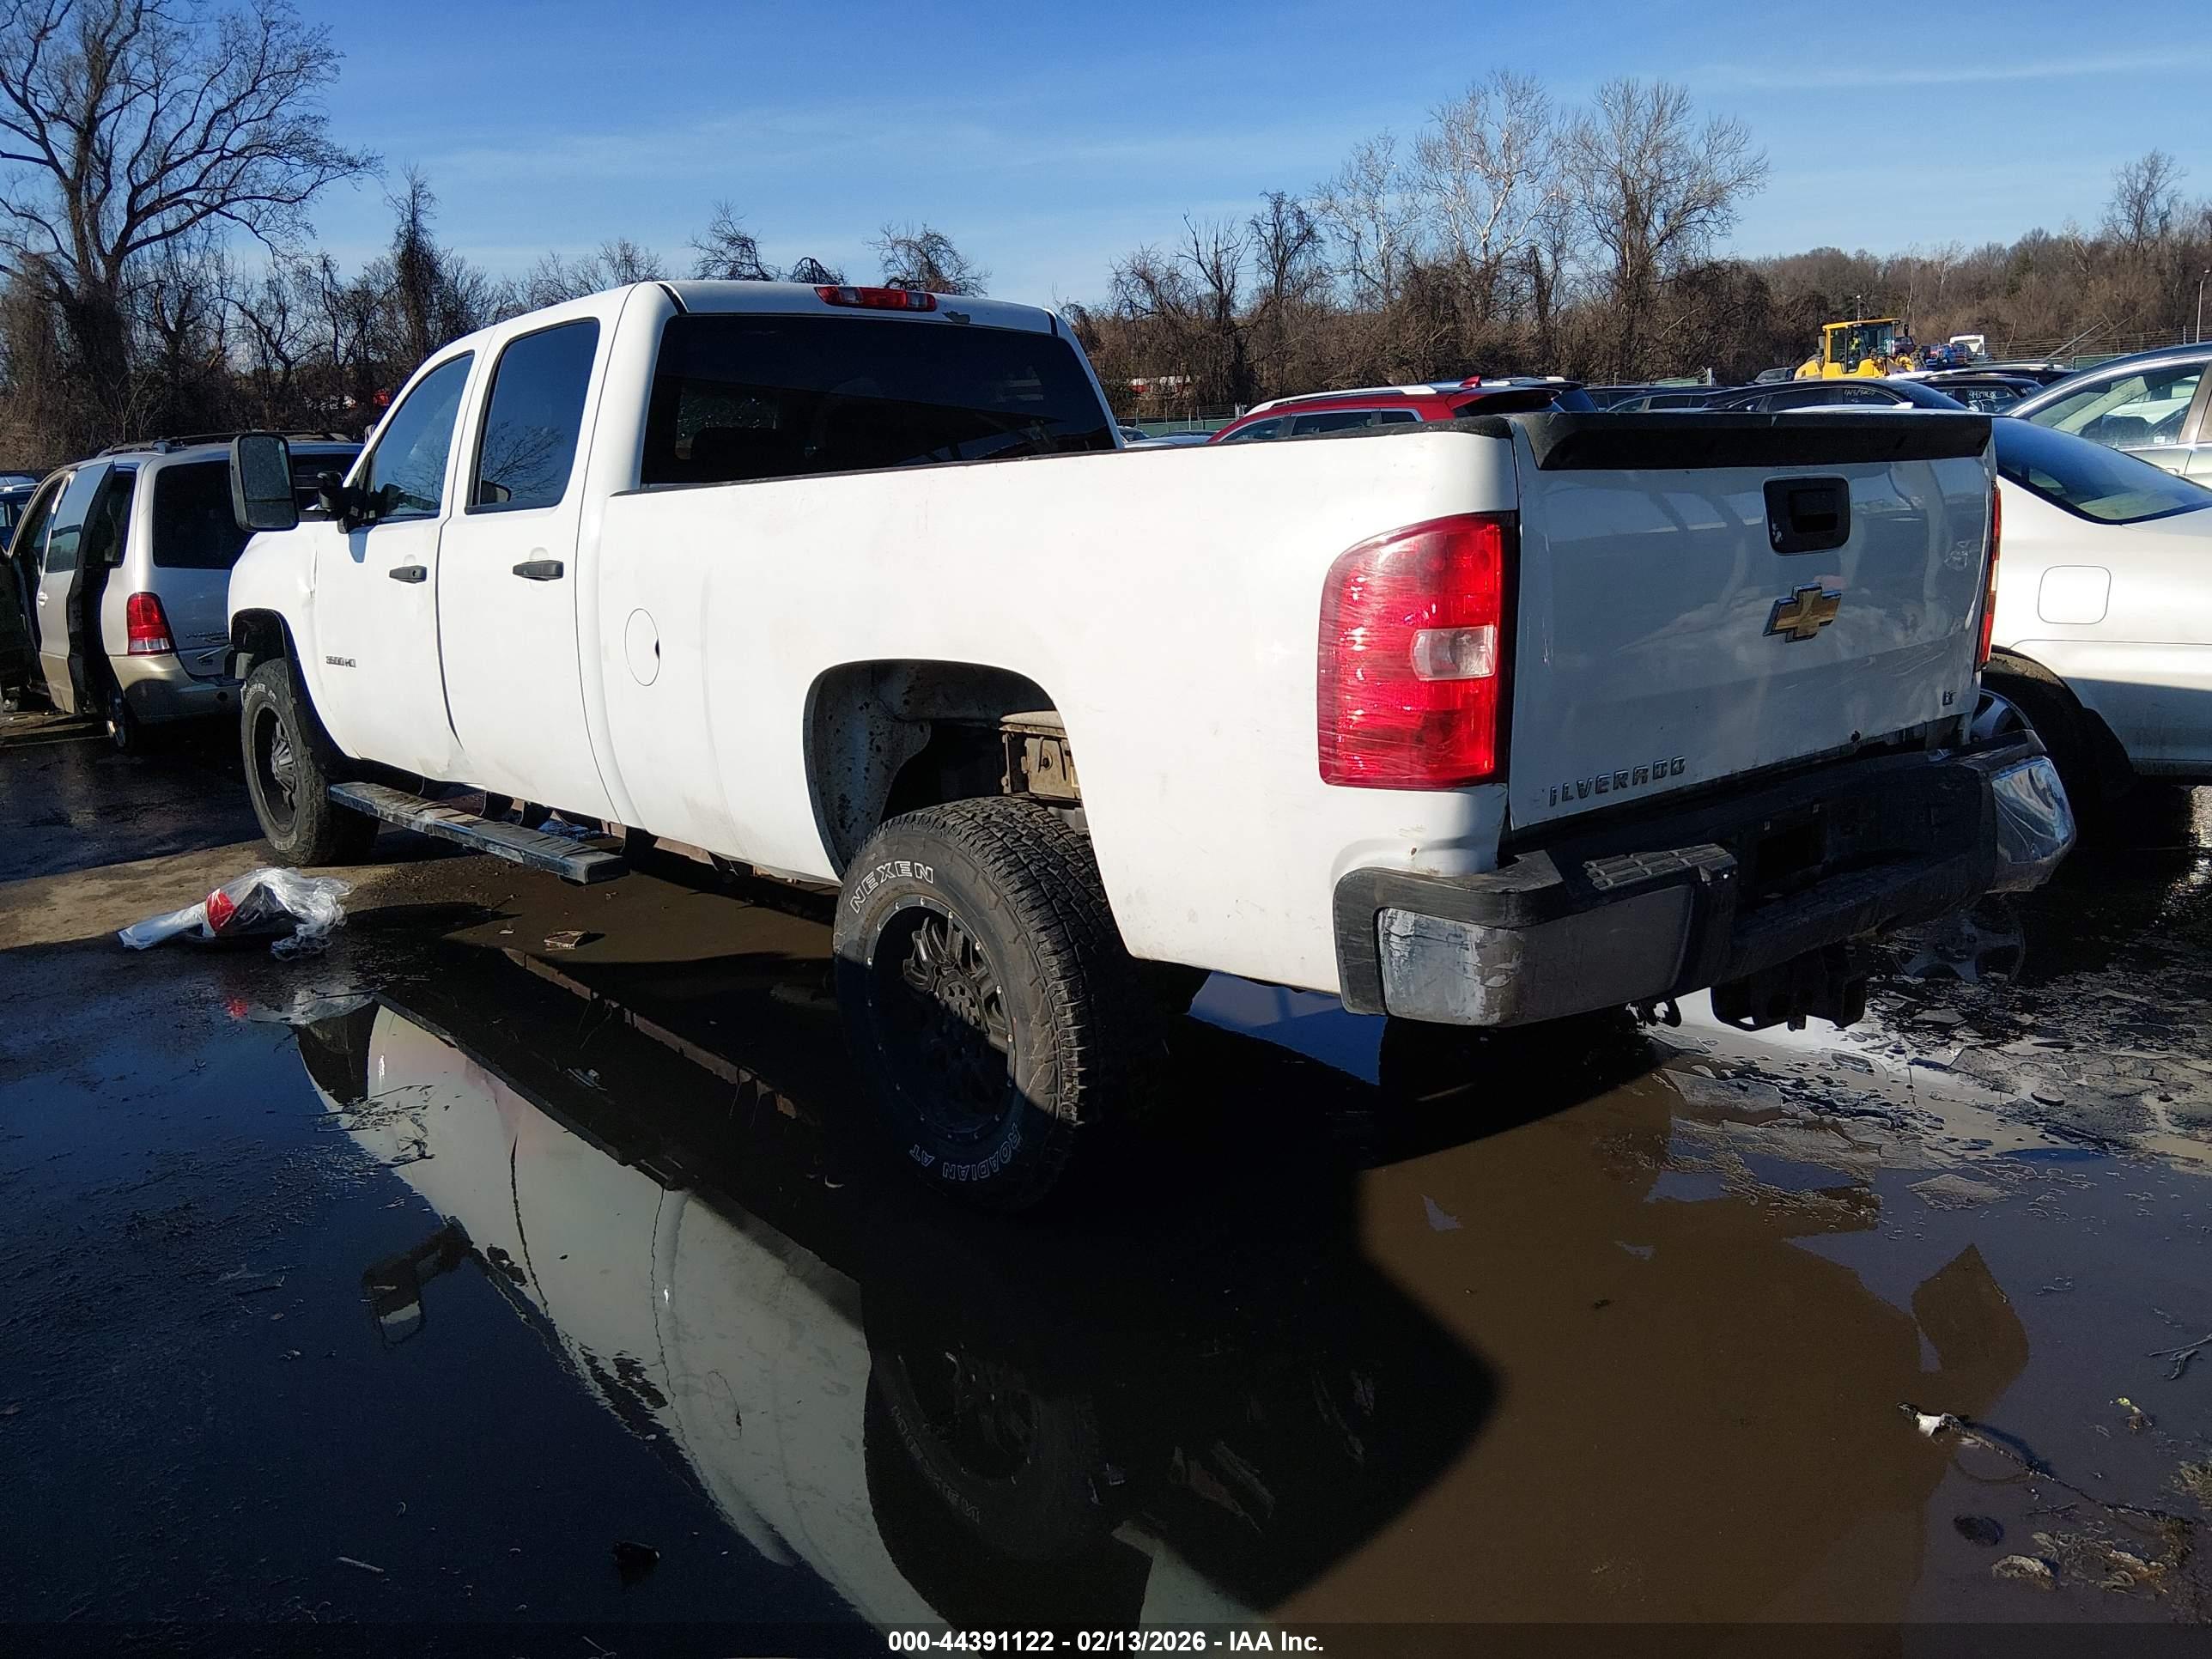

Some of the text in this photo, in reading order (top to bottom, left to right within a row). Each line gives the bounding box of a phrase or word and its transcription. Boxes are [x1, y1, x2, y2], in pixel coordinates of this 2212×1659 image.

[849, 860, 934, 915] NEXEN
[909, 1121, 1022, 1182] ROADIAN AT
